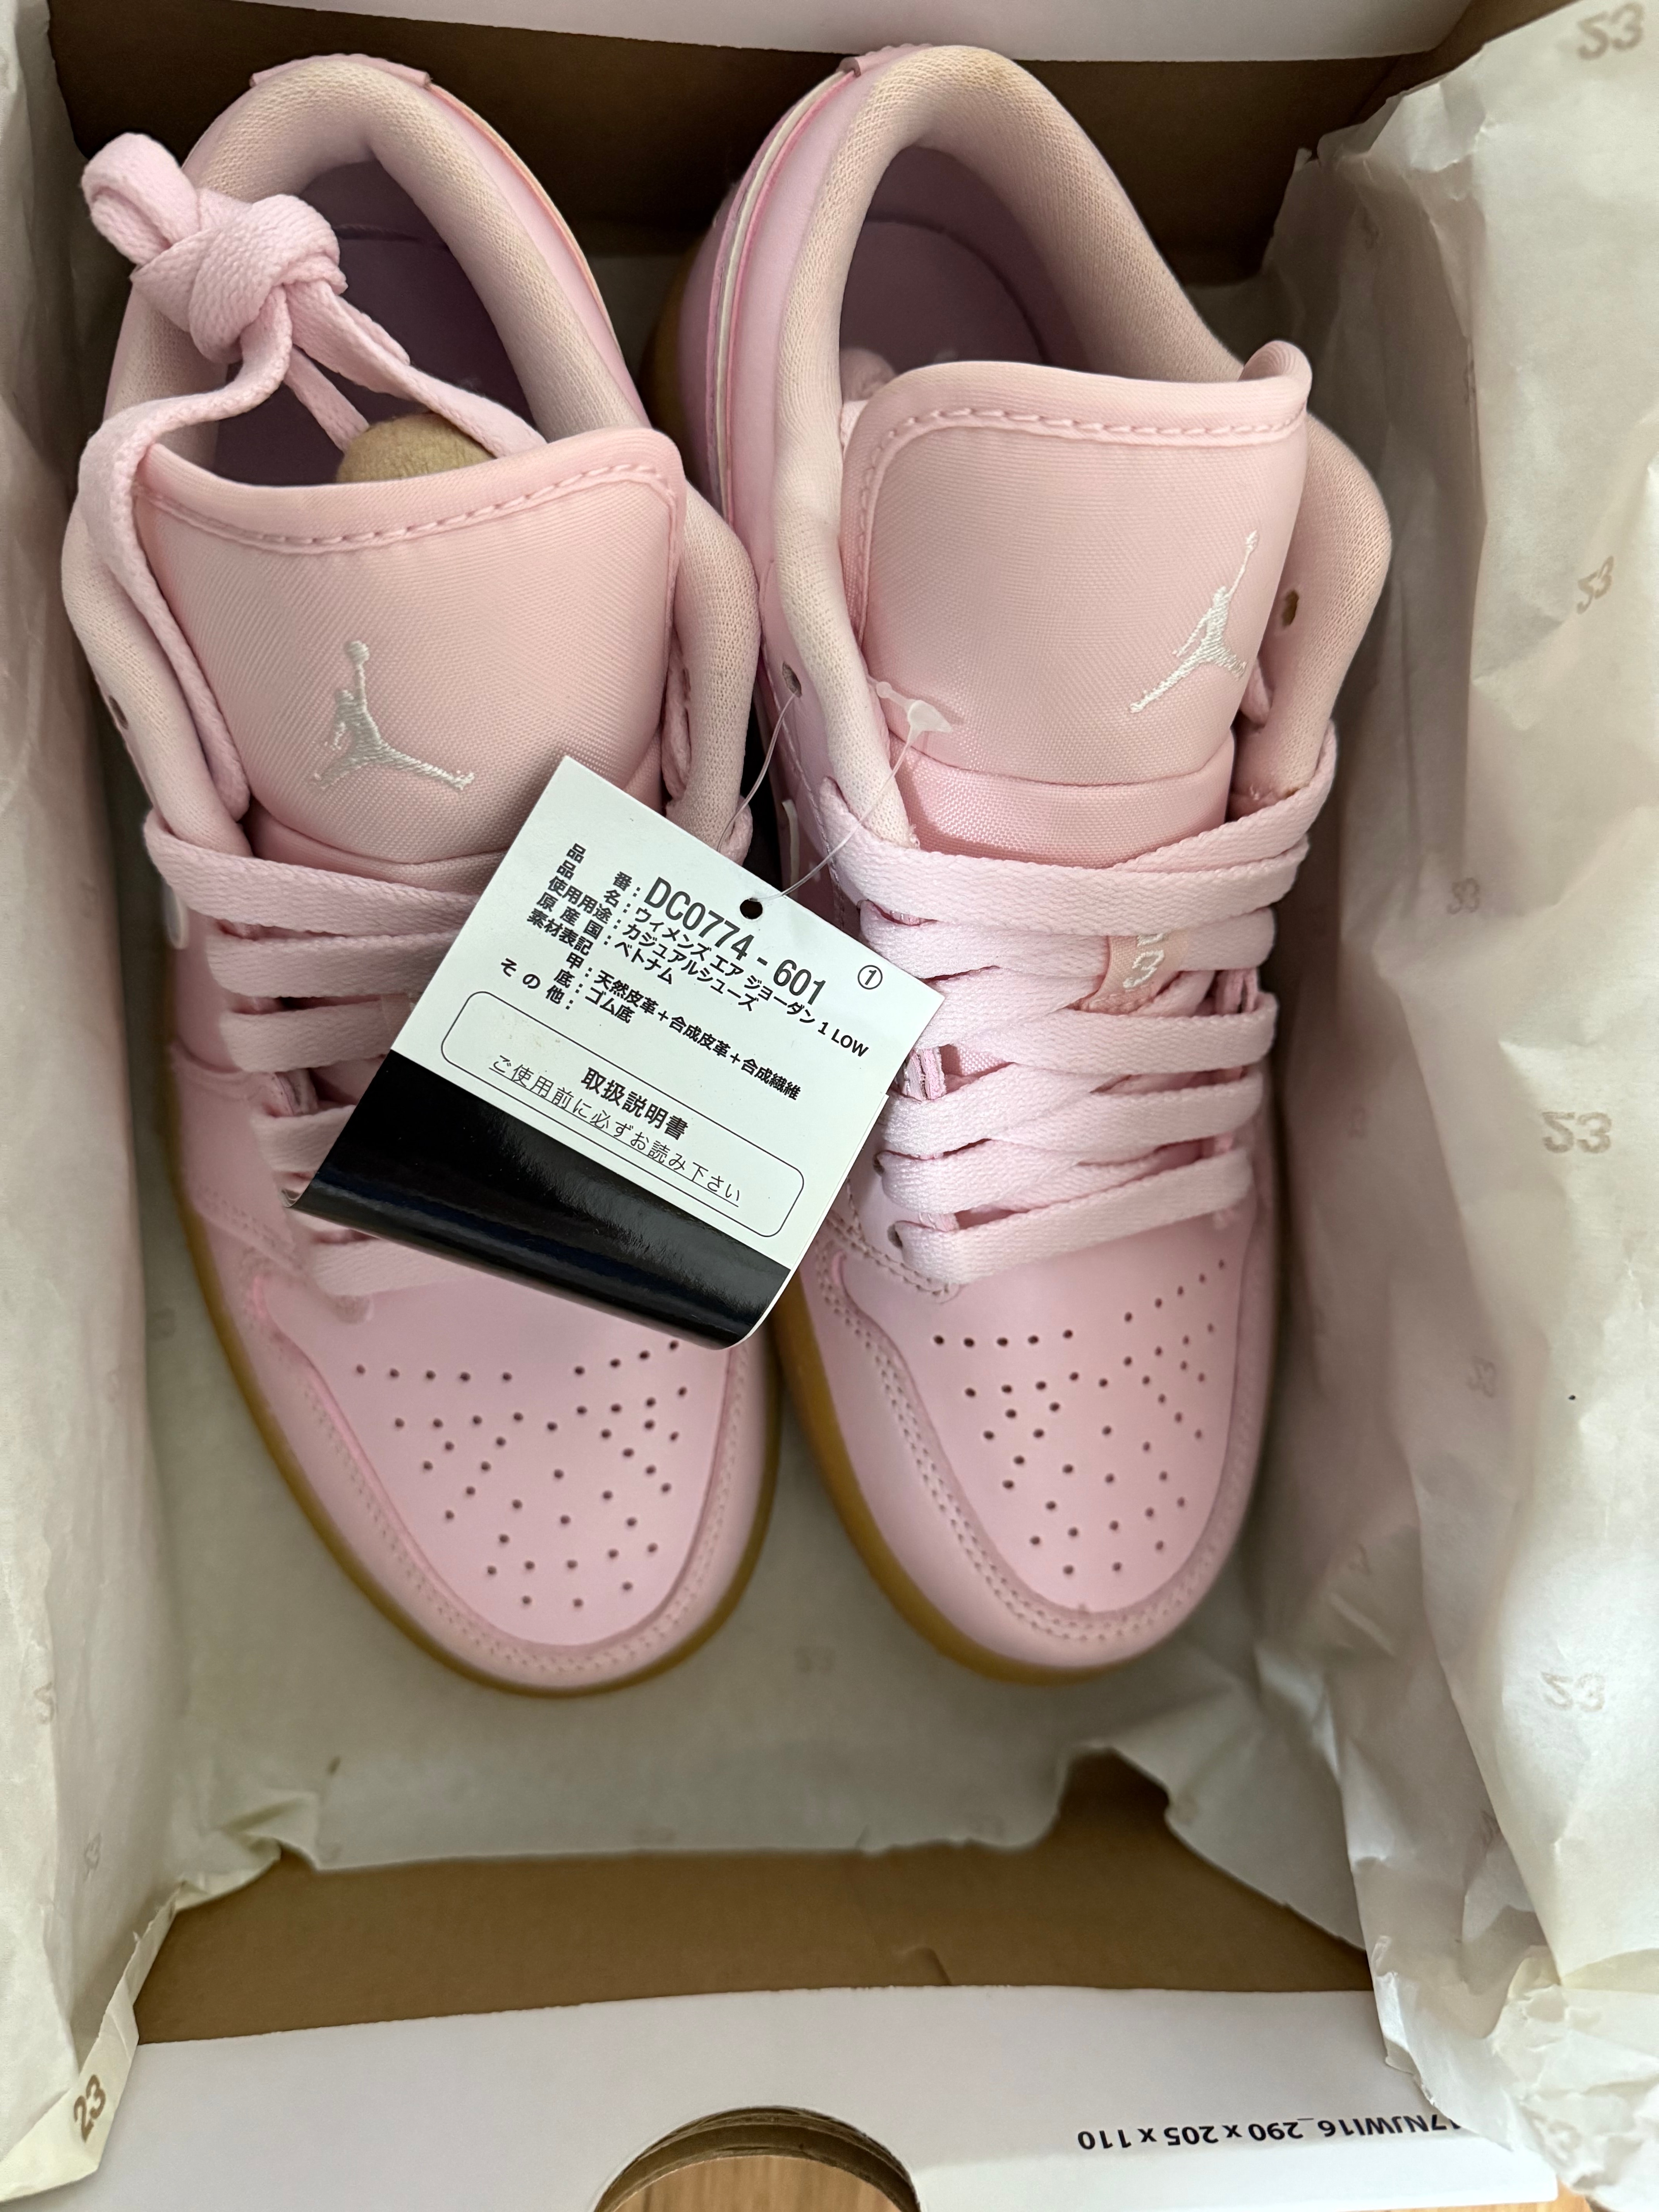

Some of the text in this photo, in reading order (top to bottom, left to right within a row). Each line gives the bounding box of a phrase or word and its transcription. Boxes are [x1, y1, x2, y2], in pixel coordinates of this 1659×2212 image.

[527, 908, 593, 956] 素材表記
[644, 877, 754, 960] DC0774
[773, 960, 826, 1005] 601
[615, 941, 672, 984] ベトナム
[622, 924, 759, 1011] カジュアルシューズ
[585, 987, 635, 1024] ゴム底
[831, 1029, 869, 1057] LOW
[581, 1067, 688, 1140] 取扱説明書
[493, 1055, 740, 1201] ご使用前に必ずお読み下さい
[73, 2074, 106, 2143] 23
[1077, 2129, 1132, 2150] 110
[1163, 2126, 1219, 2146] 205
